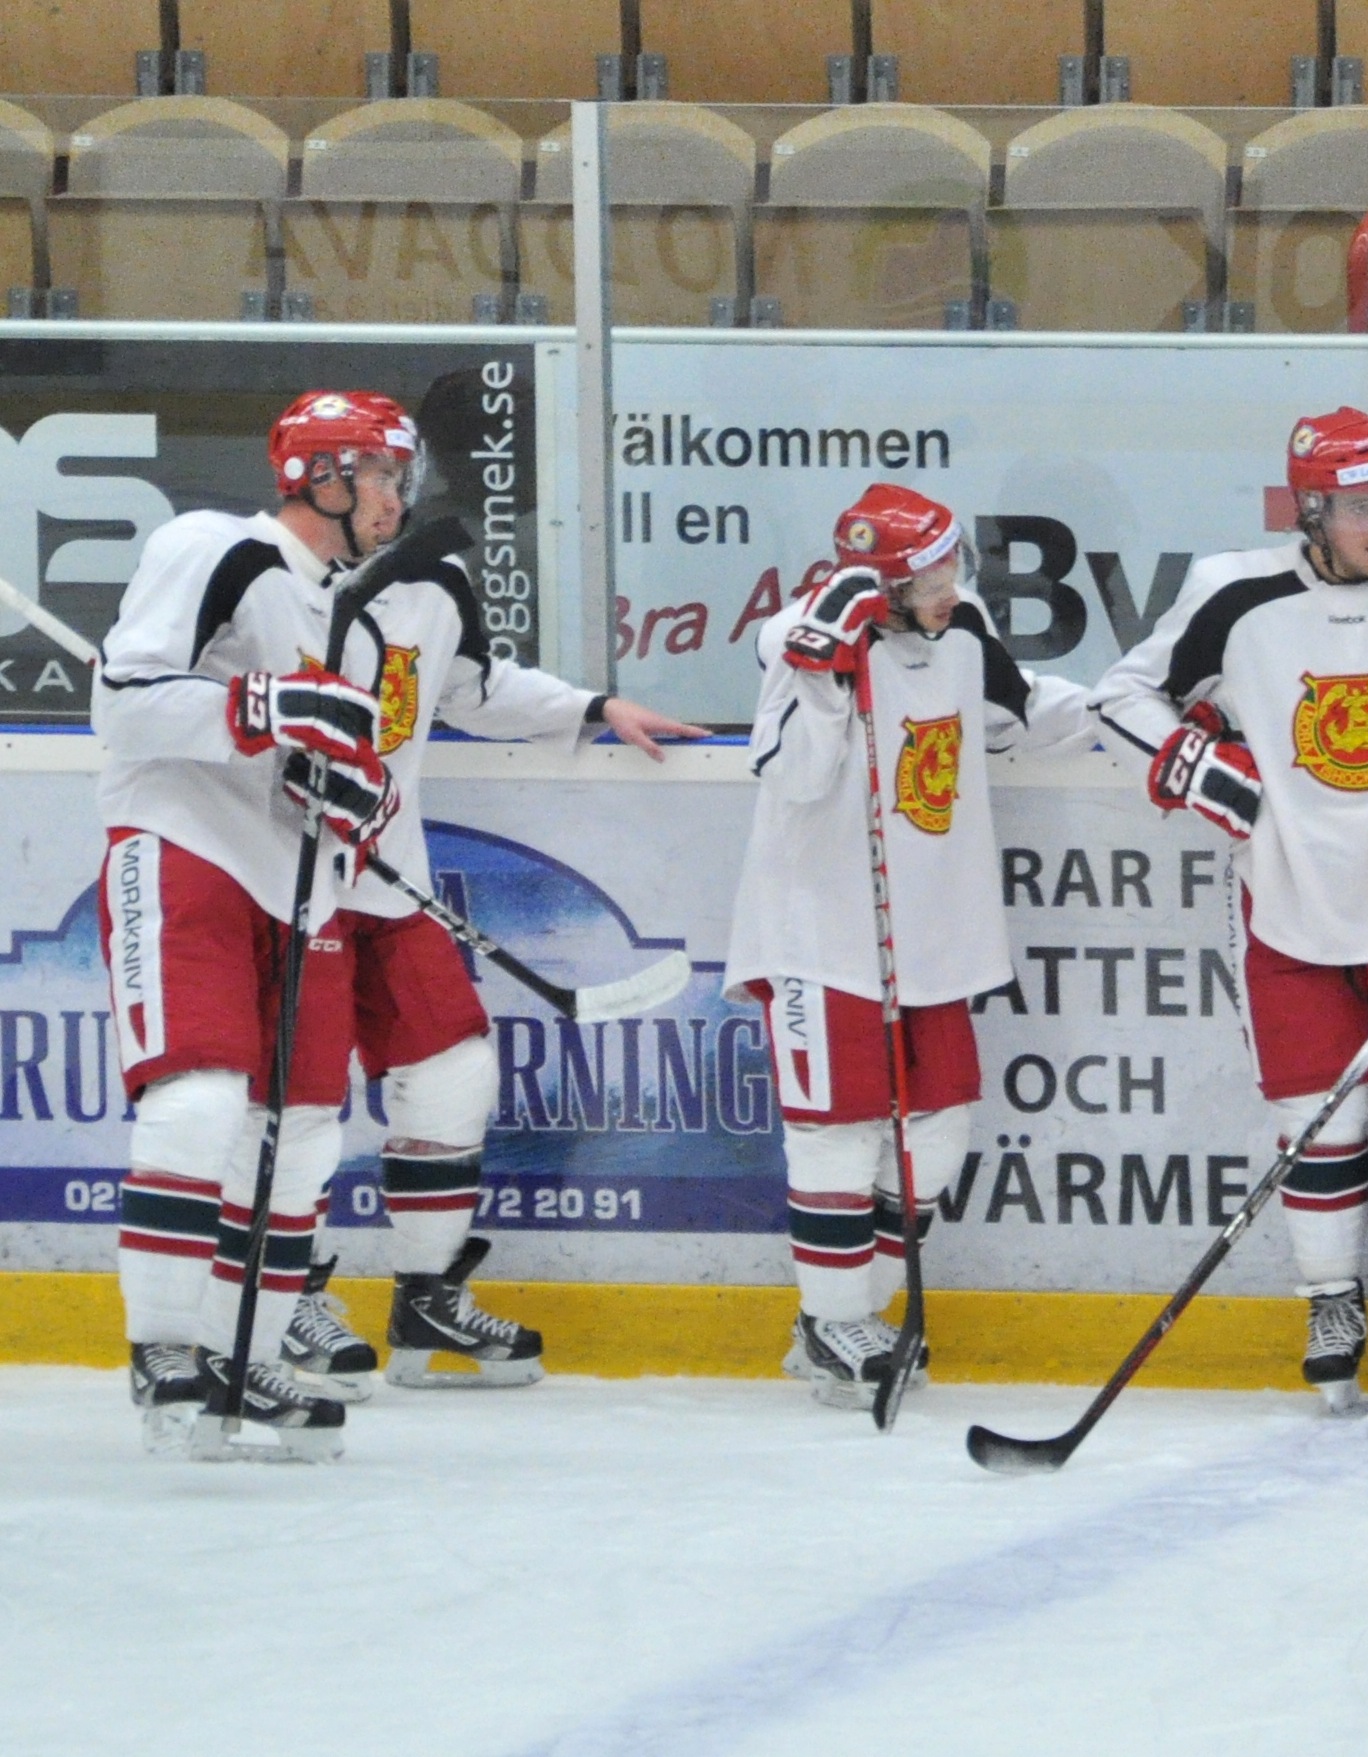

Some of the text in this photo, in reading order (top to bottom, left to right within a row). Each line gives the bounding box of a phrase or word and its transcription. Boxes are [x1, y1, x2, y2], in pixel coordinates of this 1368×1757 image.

[610, 413, 950, 468] älkommen
[471, 361, 531, 662] oggsmek.se
[621, 491, 749, 544] ll en
[1002, 848, 1152, 907] RAR
[120, 839, 143, 991] MORAKNIV
[970, 946, 1242, 1016] ATTEN
[1003, 1053, 1165, 1114] OCH
[534, 1188, 585, 1219] 20
[593, 1189, 642, 1220] 91
